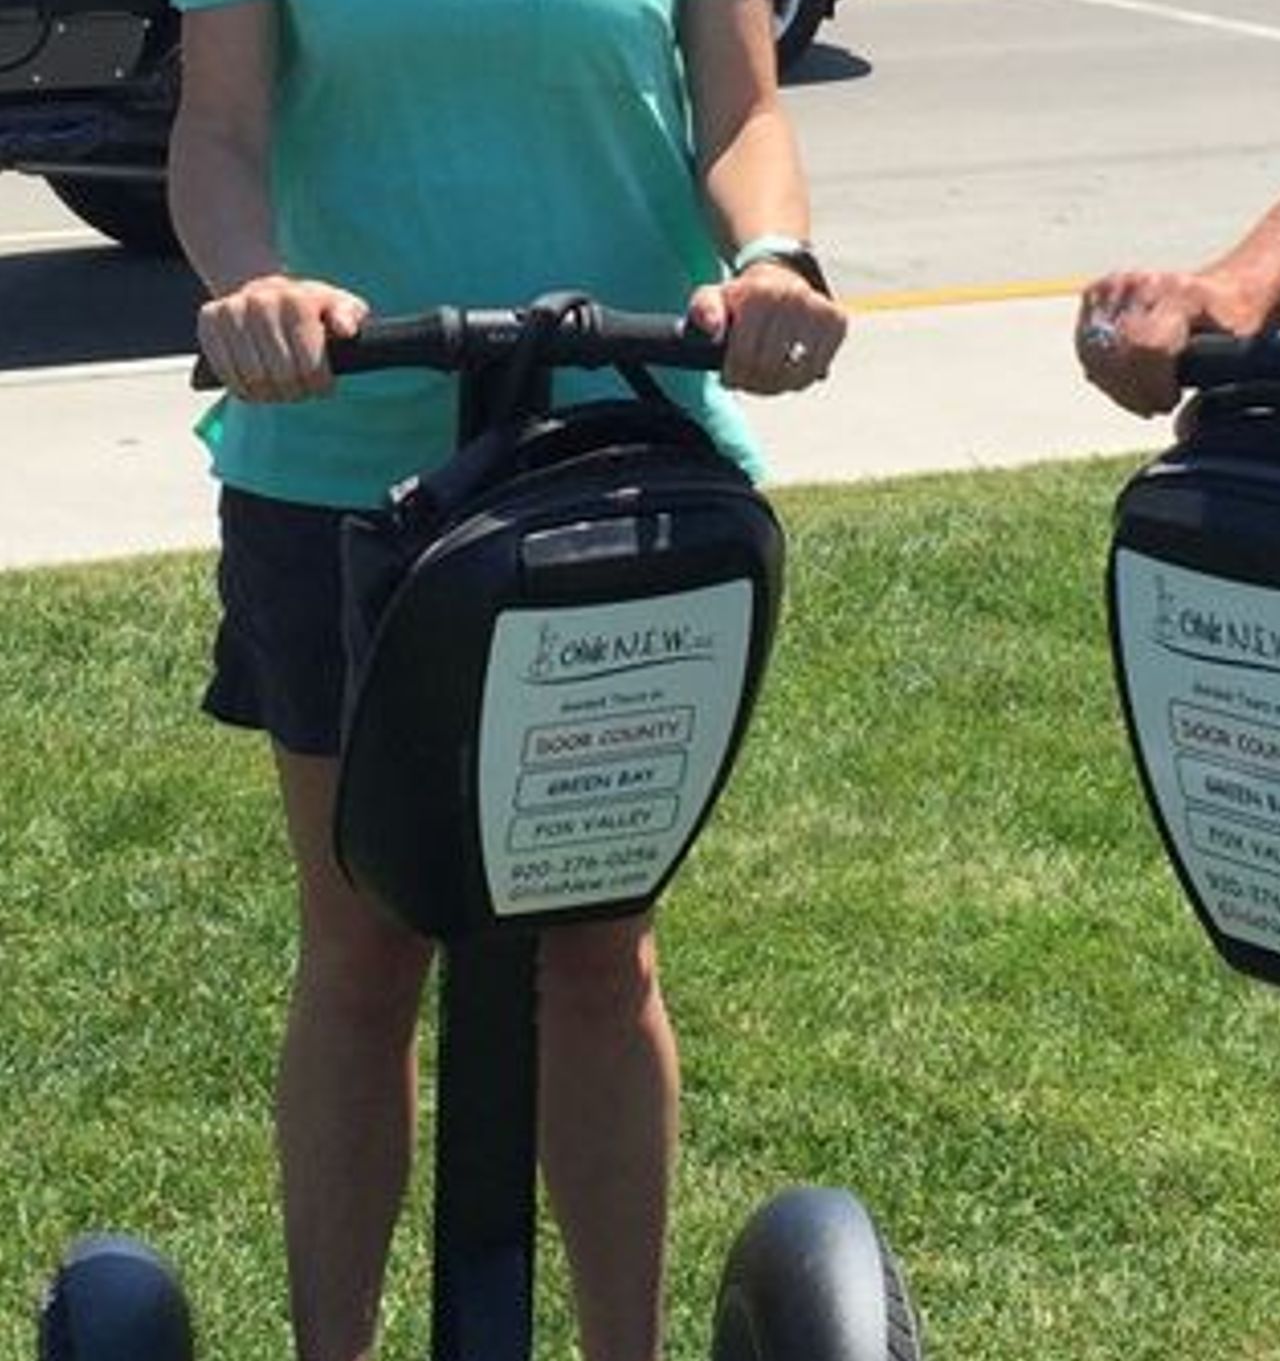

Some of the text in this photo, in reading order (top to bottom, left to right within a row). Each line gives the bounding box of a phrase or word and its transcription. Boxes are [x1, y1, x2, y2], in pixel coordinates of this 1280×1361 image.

[536, 720, 680, 755] DOOR COUNTY
[548, 769, 654, 796] GREEN BAY
[578, 808, 652, 833] VALLEY
